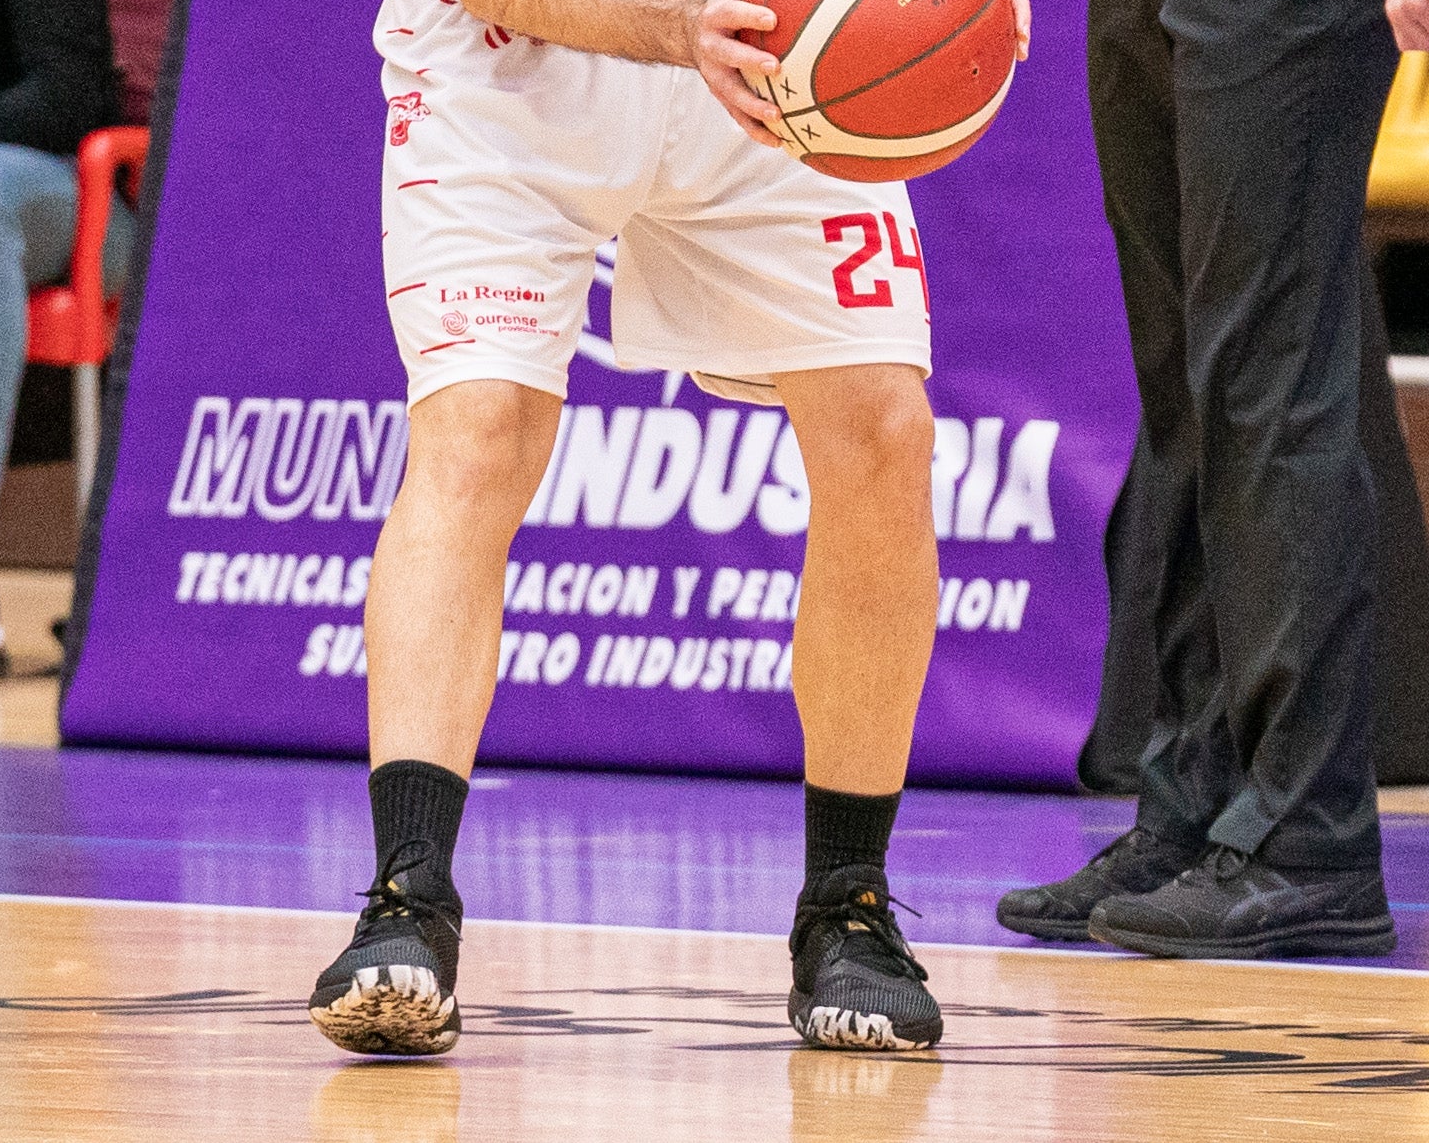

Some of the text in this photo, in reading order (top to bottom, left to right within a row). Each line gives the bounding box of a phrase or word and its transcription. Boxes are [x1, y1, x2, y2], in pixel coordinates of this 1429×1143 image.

[820, 210, 932, 314] 24
[439, 288, 469, 304] La
[475, 314, 539, 328] ourense
[176, 551, 372, 607] TECNICAS
[671, 565, 702, 620] Y
